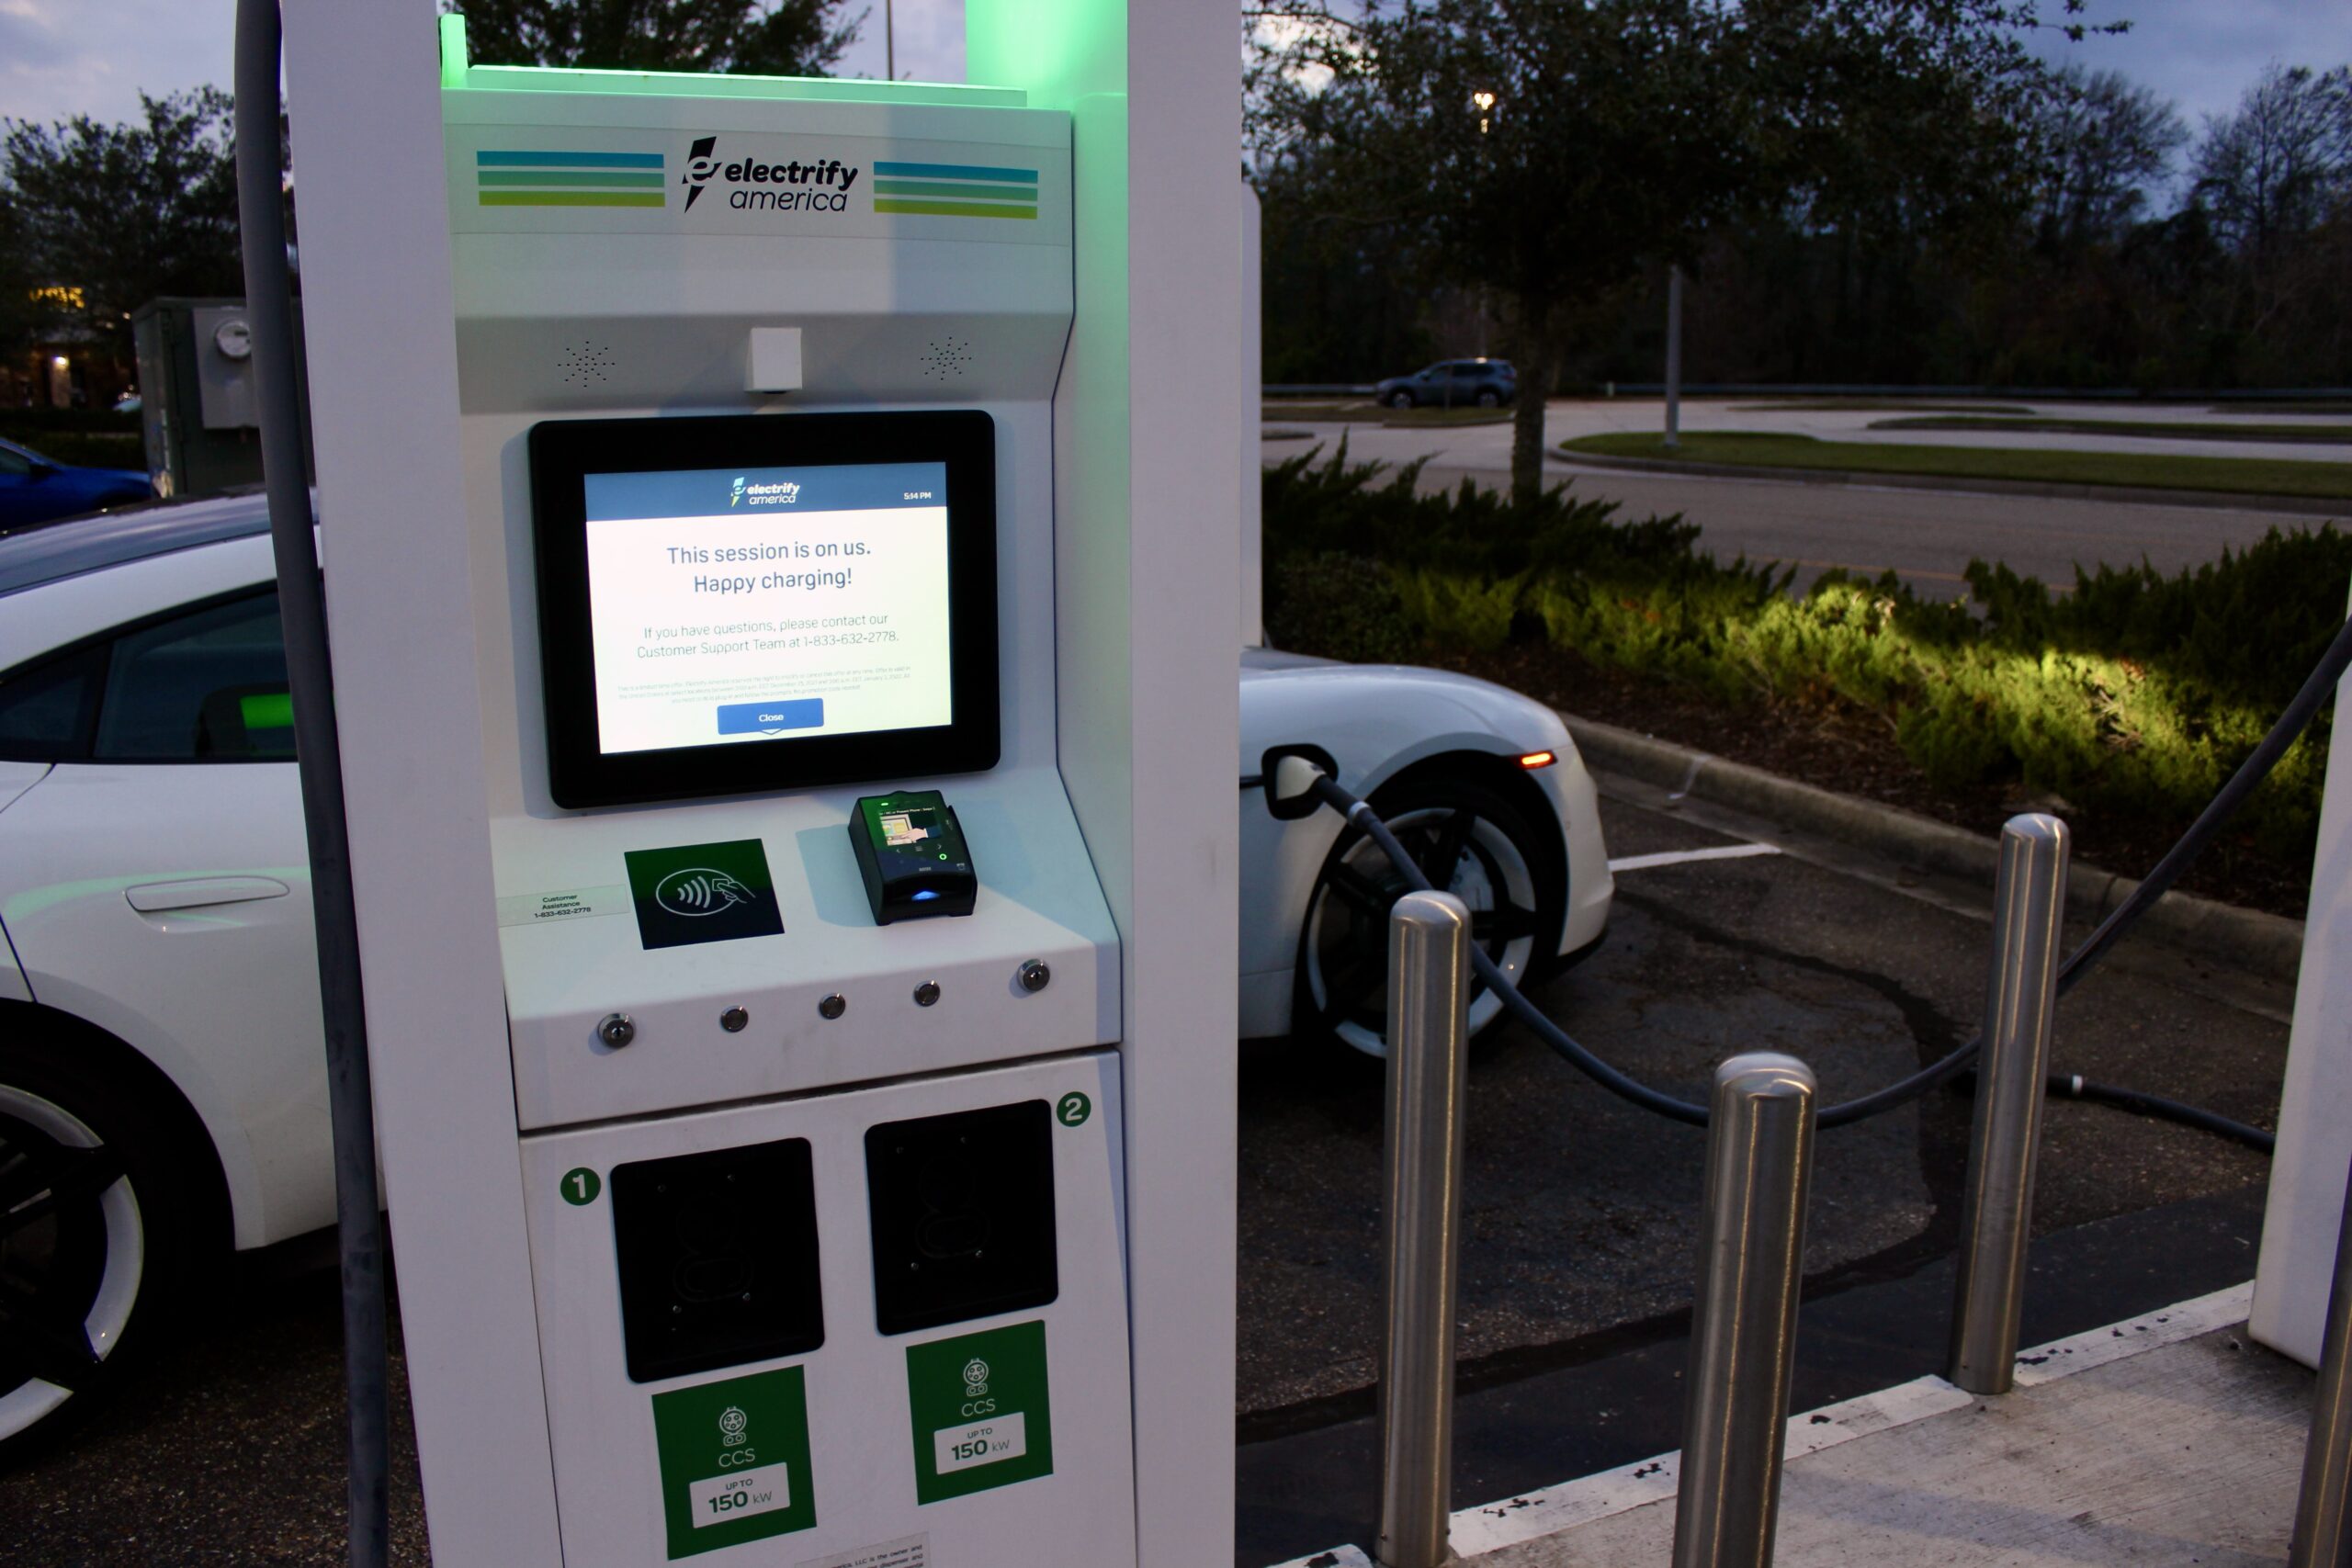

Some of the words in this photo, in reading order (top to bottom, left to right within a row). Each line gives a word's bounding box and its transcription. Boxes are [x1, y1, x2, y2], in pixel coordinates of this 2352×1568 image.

[724, 157, 859, 192] electrify
[729, 188, 848, 212] america
[747, 482, 800, 496] electrify
[903, 492, 919, 501] 5:14
[920, 491, 932, 500] PM
[749, 494, 797, 505] america
[667, 546, 709, 564] This
[714, 543, 789, 562] session
[795, 541, 810, 558] is
[814, 543, 838, 558] on
[843, 542, 871, 556] us.
[694, 575, 756, 594] Happy
[761, 568, 853, 590] charging!
[644, 626, 652, 638] If
[655, 628, 677, 641] you
[681, 625, 710, 637] have
[713, 621, 776, 636] questions,
[779, 618, 819, 632] please
[821, 615, 866, 627] contact
[869, 614, 888, 625] our
[637, 645, 696, 659] Customer
[700, 641, 750, 655] Support
[753, 638, 786, 649] Team
[788, 637, 800, 648] at
[803, 630, 899, 647] 1-833-632-2778.
[758, 714, 784, 722] Close
[542, 895, 578, 903] Customer
[542, 901, 580, 909] Assistance
[534, 907, 591, 918] 1-833-632-2778
[1066, 1098, 1082, 1121] 2
[573, 1174, 586, 1199] 1
[961, 1398, 996, 1416] CCS
[967, 1430, 979, 1438] UP
[980, 1427, 993, 1436] TO
[718, 1448, 755, 1468] CCS
[951, 1439, 988, 1461] 150
[992, 1439, 1010, 1451] kW
[725, 1482, 738, 1491] UP
[740, 1478, 753, 1487] TO
[708, 1491, 748, 1514] 150
[752, 1491, 772, 1505] kW
[910, 1544, 922, 1552] and
